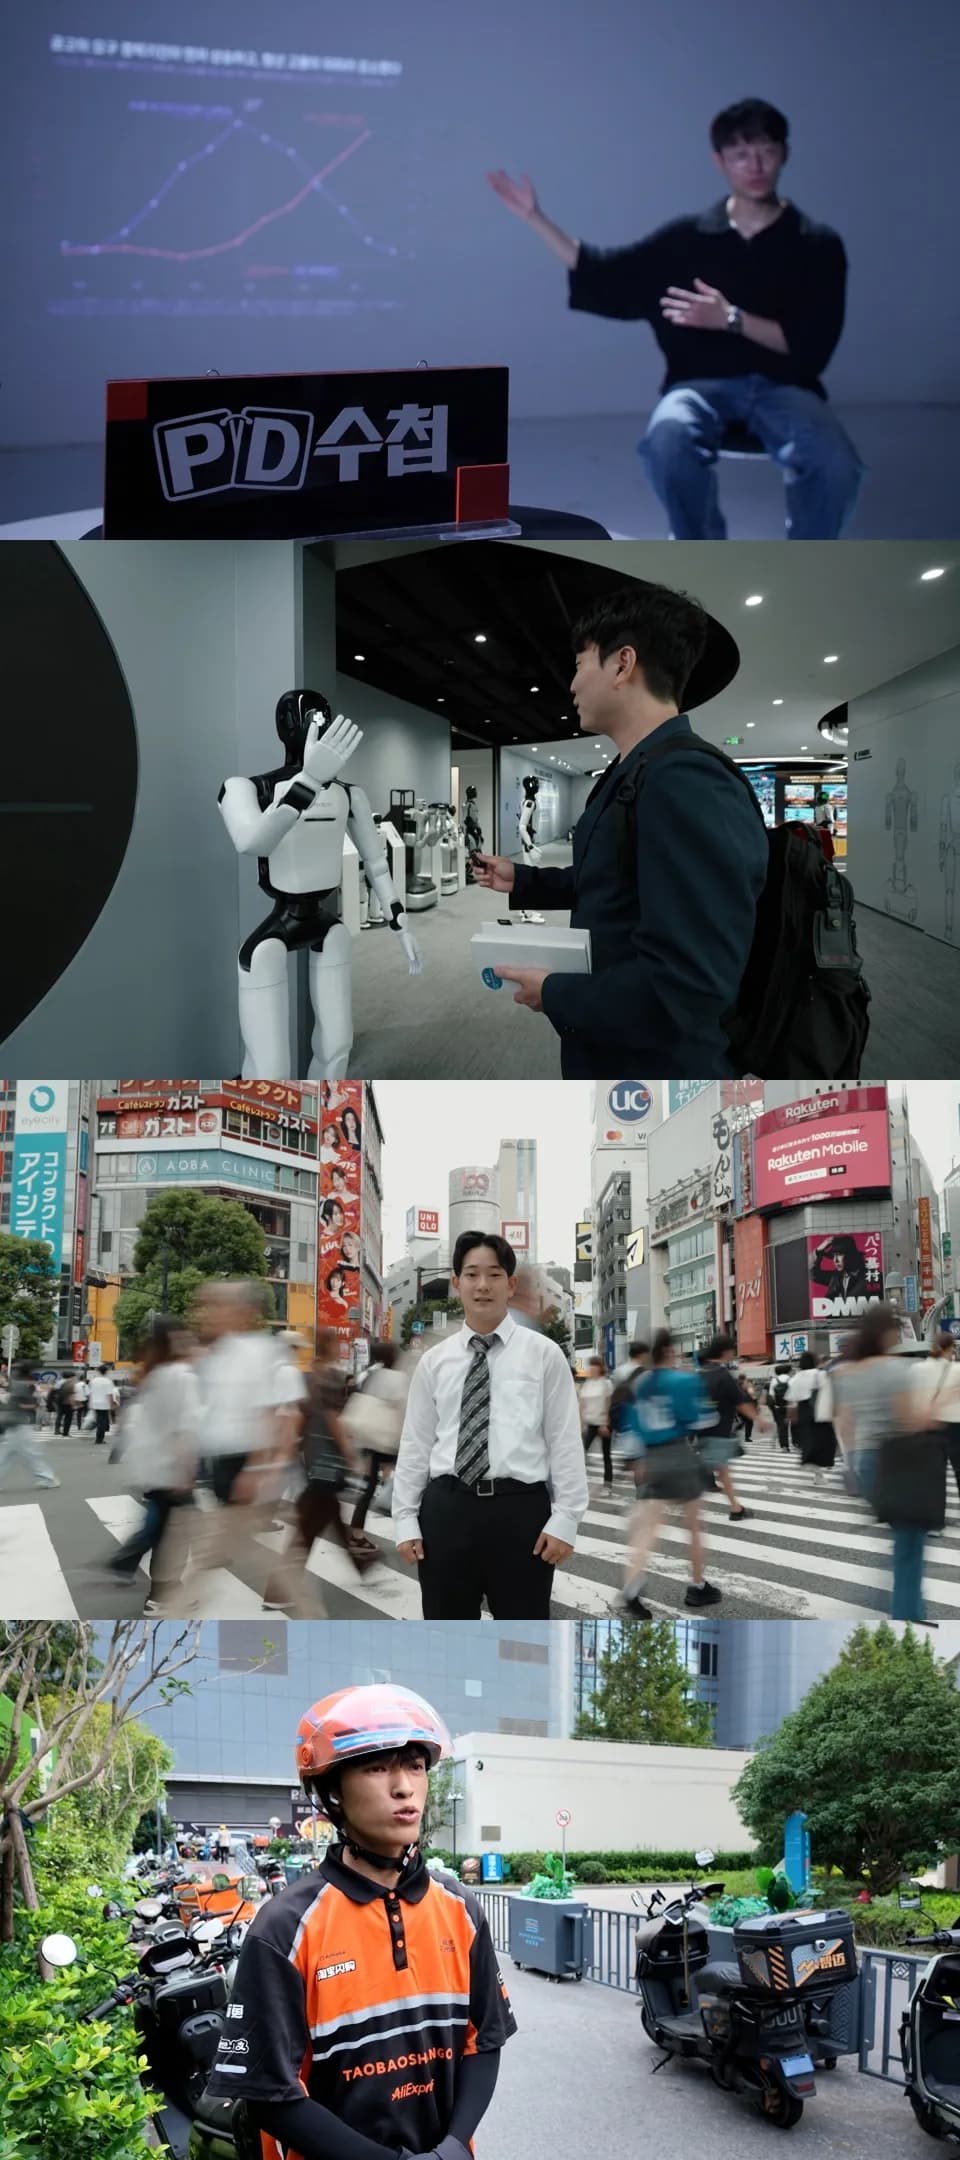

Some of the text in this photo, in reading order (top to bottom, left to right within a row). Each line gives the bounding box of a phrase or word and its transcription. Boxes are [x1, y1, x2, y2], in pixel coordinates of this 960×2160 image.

[163, 403, 449, 494] PD수첩
[167, 1095, 205, 1110] ガスト
[785, 1097, 839, 1119] Rakuten
[99, 1121, 116, 1134] 7F
[144, 1117, 191, 1137] ガスト
[712, 1113, 732, 1199] もんじゃ
[768, 1146, 820, 1171] Rakuten
[822, 1140, 869, 1157] Mobile
[167, 1160, 274, 1182] AOBA CLINIC
[420, 1213, 436, 1222] UNI
[420, 1222, 437, 1231] QLO
[812, 1295, 881, 1318] DMM
